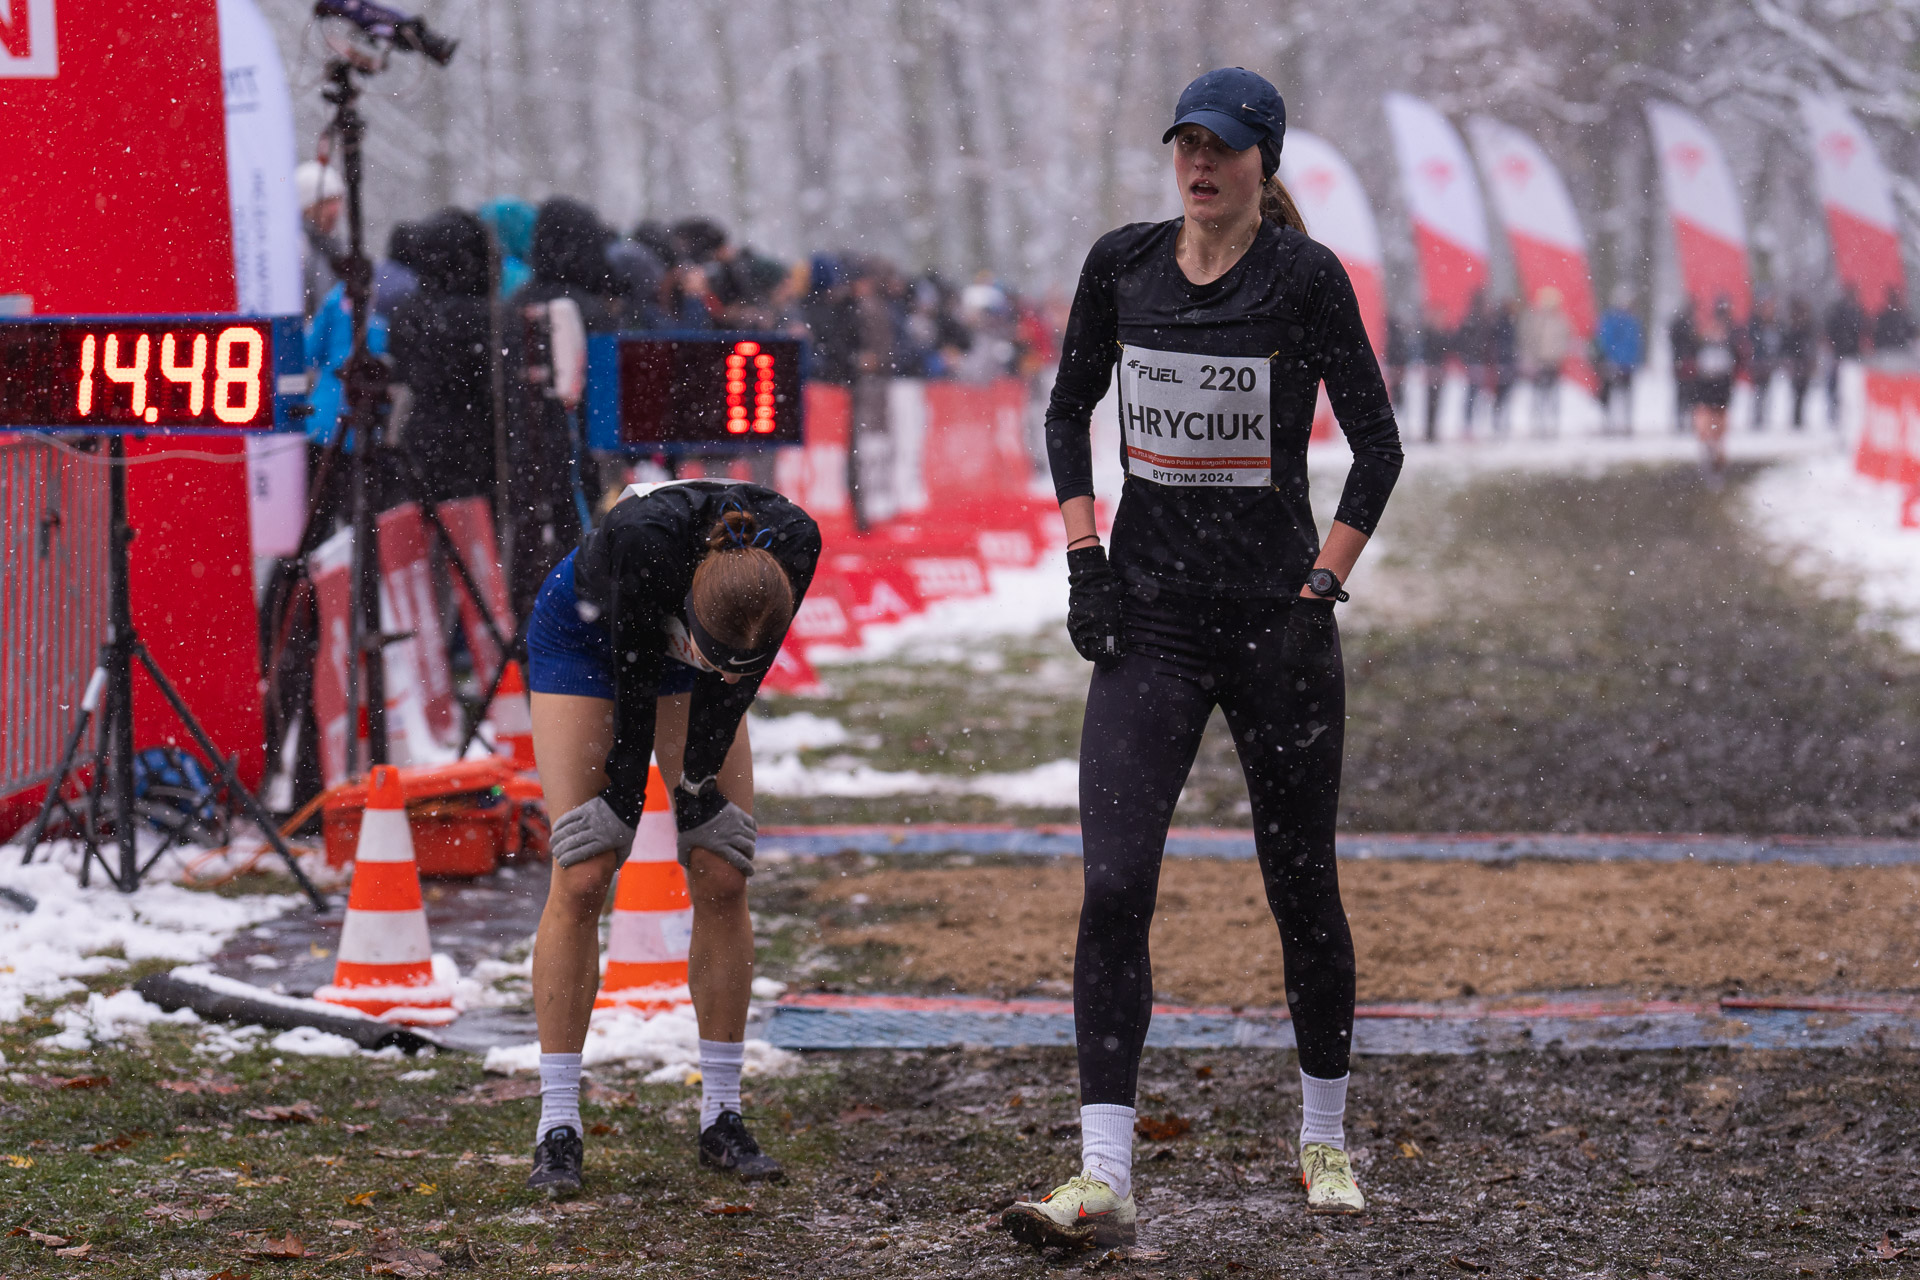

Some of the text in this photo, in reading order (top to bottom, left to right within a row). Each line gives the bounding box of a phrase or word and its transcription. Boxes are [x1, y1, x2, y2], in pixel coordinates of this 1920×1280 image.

[77, 327, 263, 423] 14.48
[1138, 365, 1183, 384] FUEL
[1200, 365, 1257, 392] 220
[1127, 403, 1265, 441] HRYCIUK
[1153, 469, 1234, 483] BYTOM 2024
